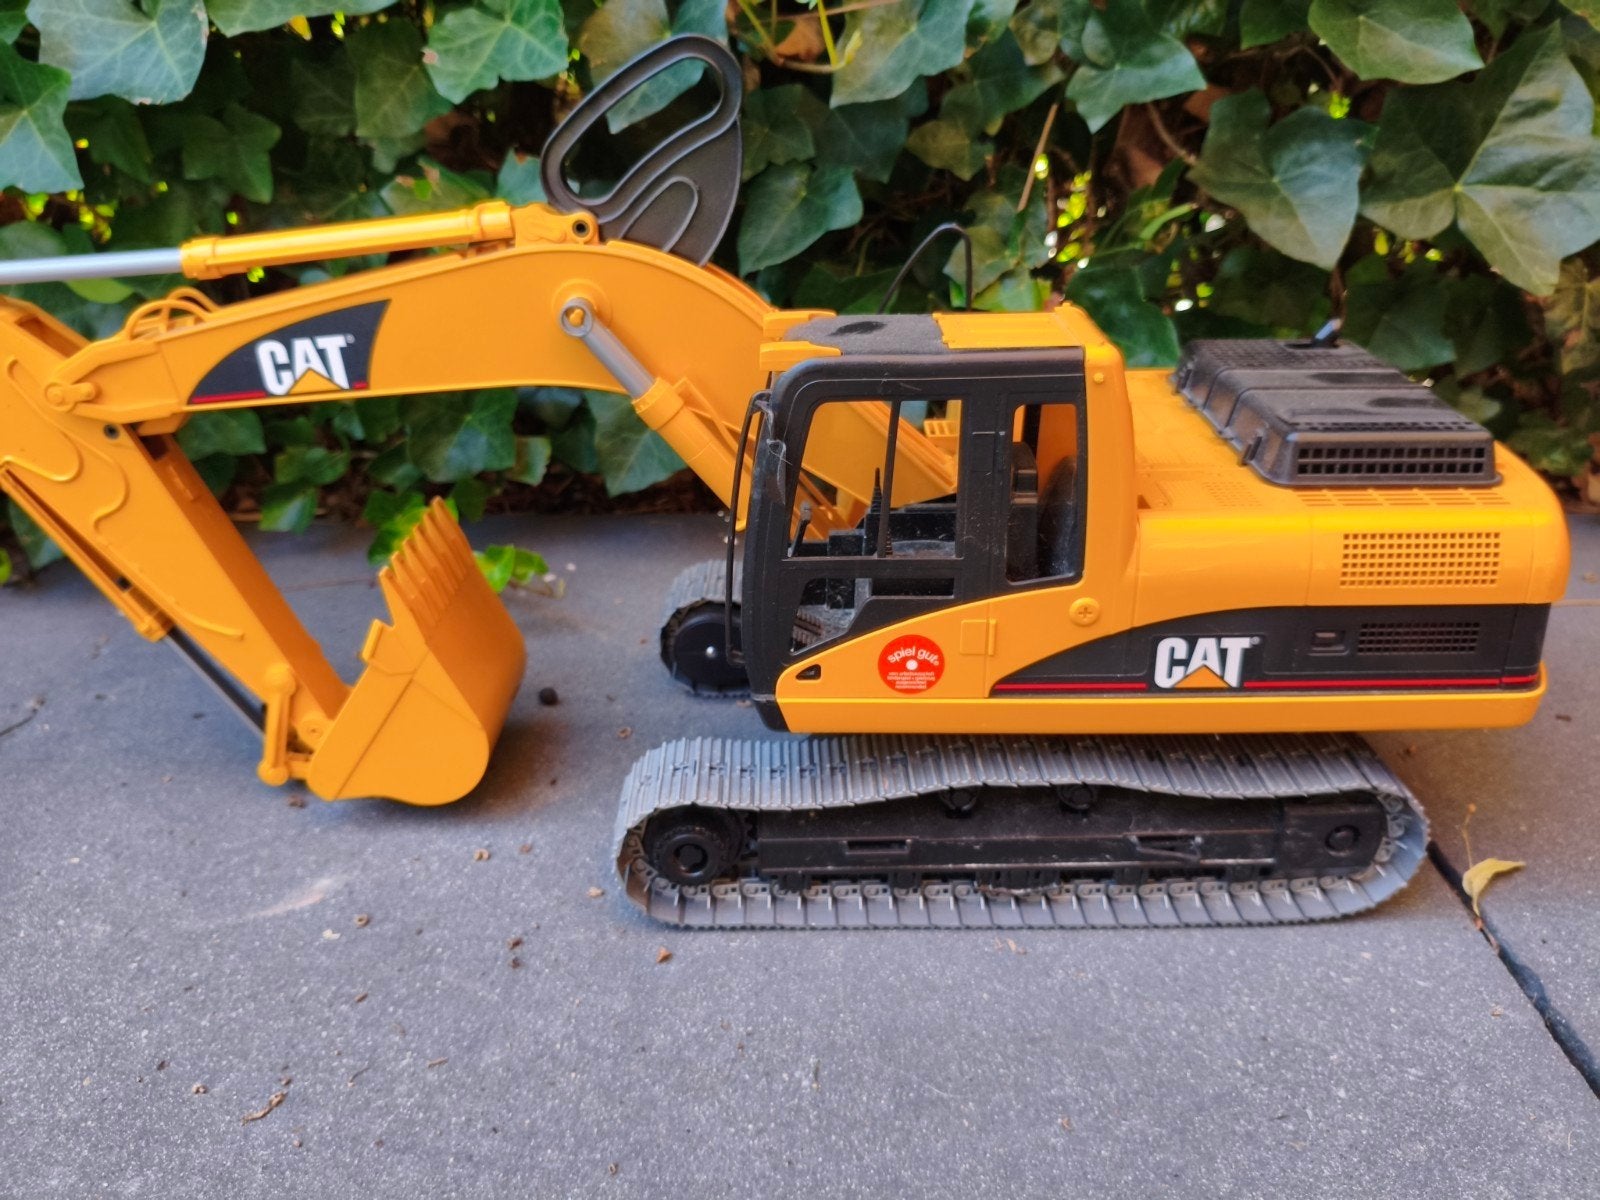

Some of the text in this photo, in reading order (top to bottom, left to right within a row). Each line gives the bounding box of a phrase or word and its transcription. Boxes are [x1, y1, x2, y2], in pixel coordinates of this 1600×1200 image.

[256, 334, 350, 395] CAT
[887, 646, 939, 665] spiel gut
[1154, 637, 1252, 688] CAT
